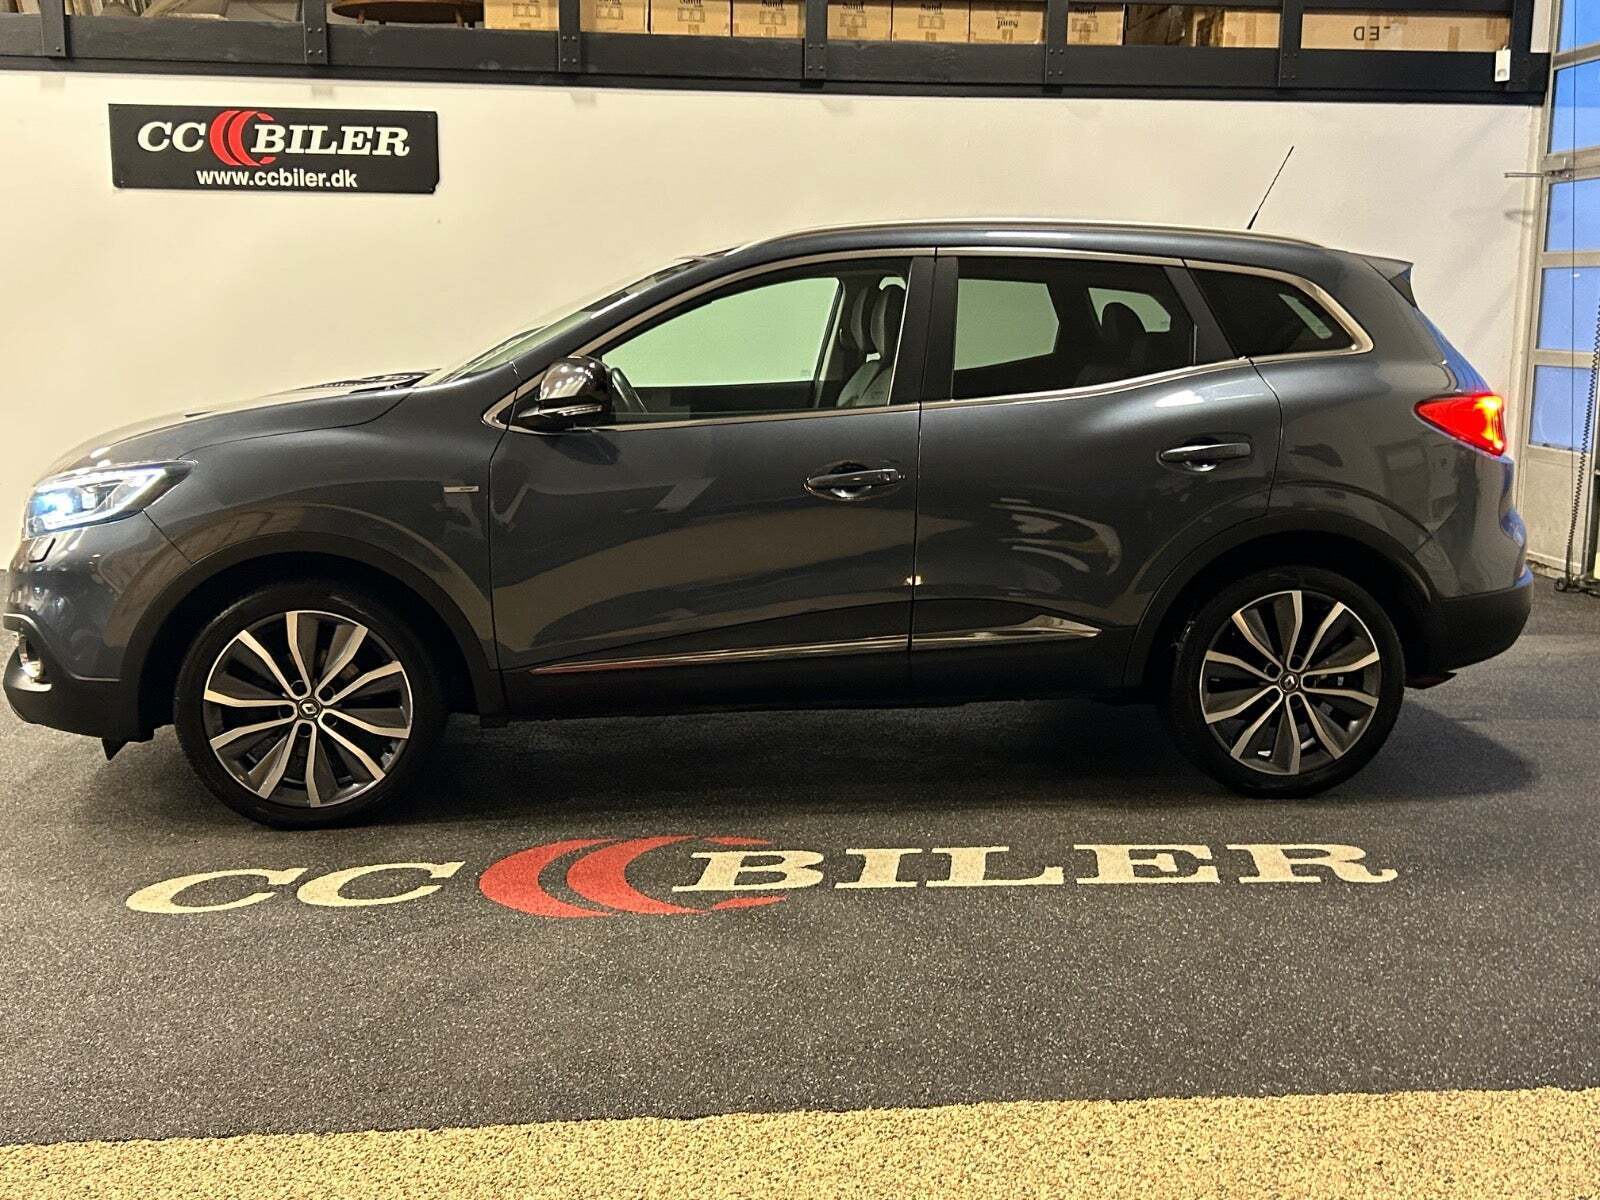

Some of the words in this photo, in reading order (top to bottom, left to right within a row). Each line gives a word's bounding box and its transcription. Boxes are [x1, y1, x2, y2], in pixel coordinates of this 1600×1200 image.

[1353, 26, 1390, 41] ED
[137, 121, 206, 152] CC
[250, 124, 410, 156] BILER
[196, 168, 358, 187] www.ccbiler.dk
[126, 860, 464, 914] CC
[671, 842, 1398, 892] BILER
